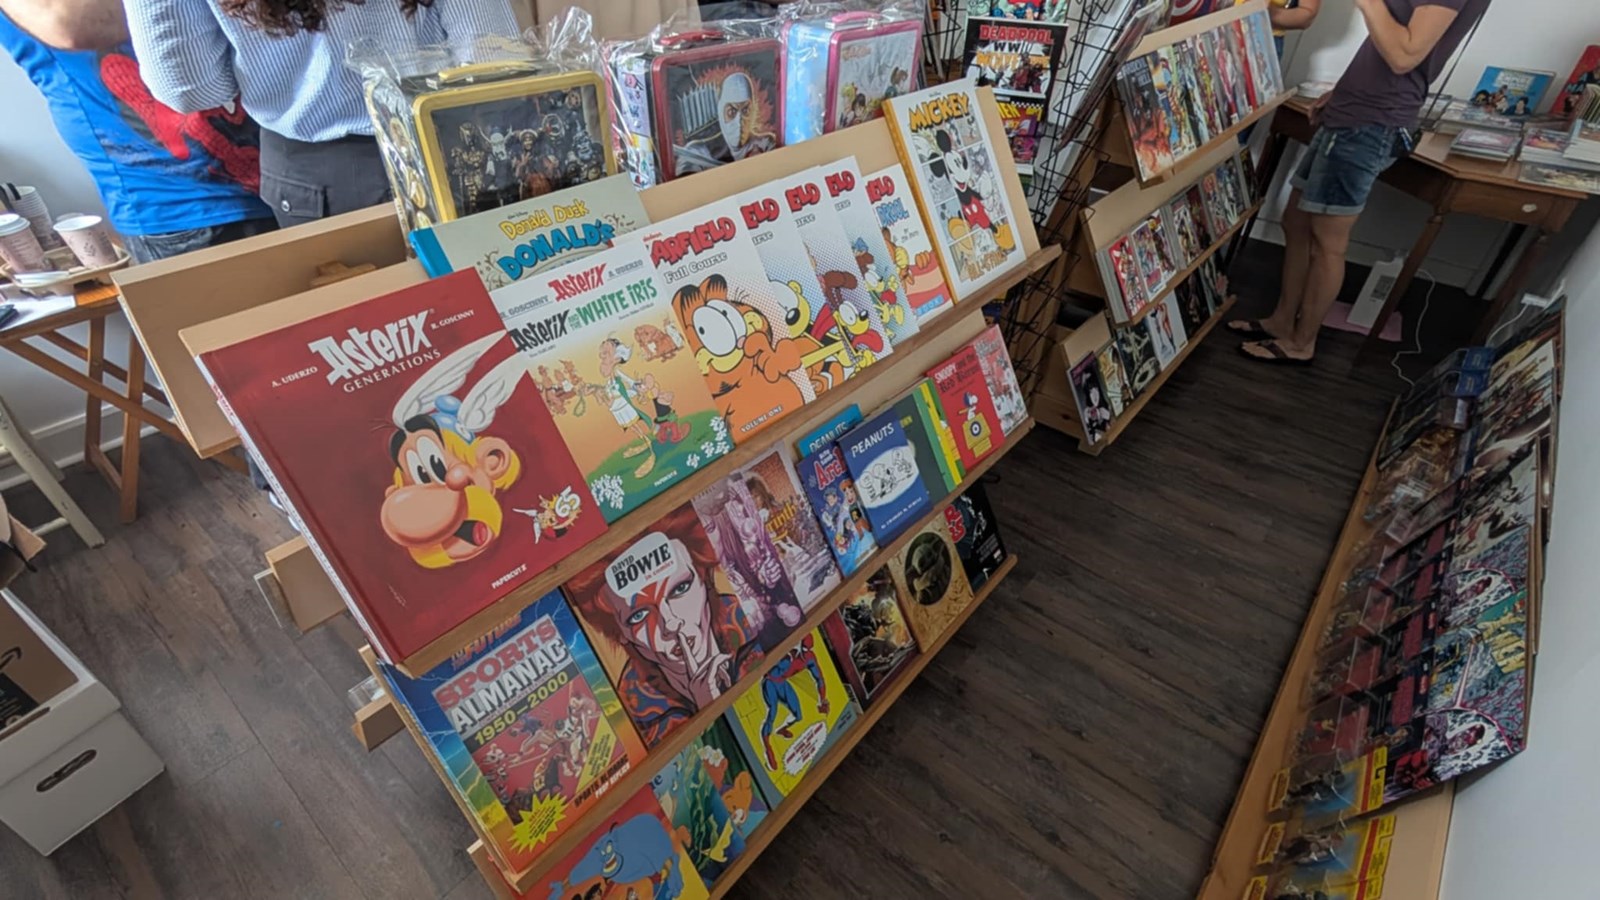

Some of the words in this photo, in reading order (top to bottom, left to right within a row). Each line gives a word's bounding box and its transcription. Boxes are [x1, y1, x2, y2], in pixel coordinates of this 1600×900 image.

[979, 24, 1054, 45] DEADPOOL
[908, 92, 969, 132] MICKEY
[499, 209, 553, 241] Donald
[553, 199, 589, 223] Duck
[649, 216, 737, 268] ARFIELD
[548, 263, 607, 302] Asterix
[615, 259, 643, 275] UDERZO
[664, 263, 689, 285] Full
[688, 251, 728, 275] Course
[439, 309, 475, 327] GOSCINNY
[507, 308, 570, 352] Asterix
[576, 289, 629, 326] WHITE
[626, 277, 658, 305] IRIS
[508, 295, 549, 315] GOSCINNY
[308, 309, 432, 385] Asterix
[282, 366, 318, 385] UDERZO
[343, 348, 441, 393] GENERATIONS
[934, 363, 957, 383] SNOOPY
[851, 422, 895, 458] PEANUTS
[554, 485, 581, 518] 65
[491, 563, 528, 589] PAPERCUTZ
[611, 554, 635, 573] DAVID
[614, 543, 671, 591] BOWIE
[433, 617, 559, 709] SPORTS
[449, 638, 568, 734] ALMANAC
